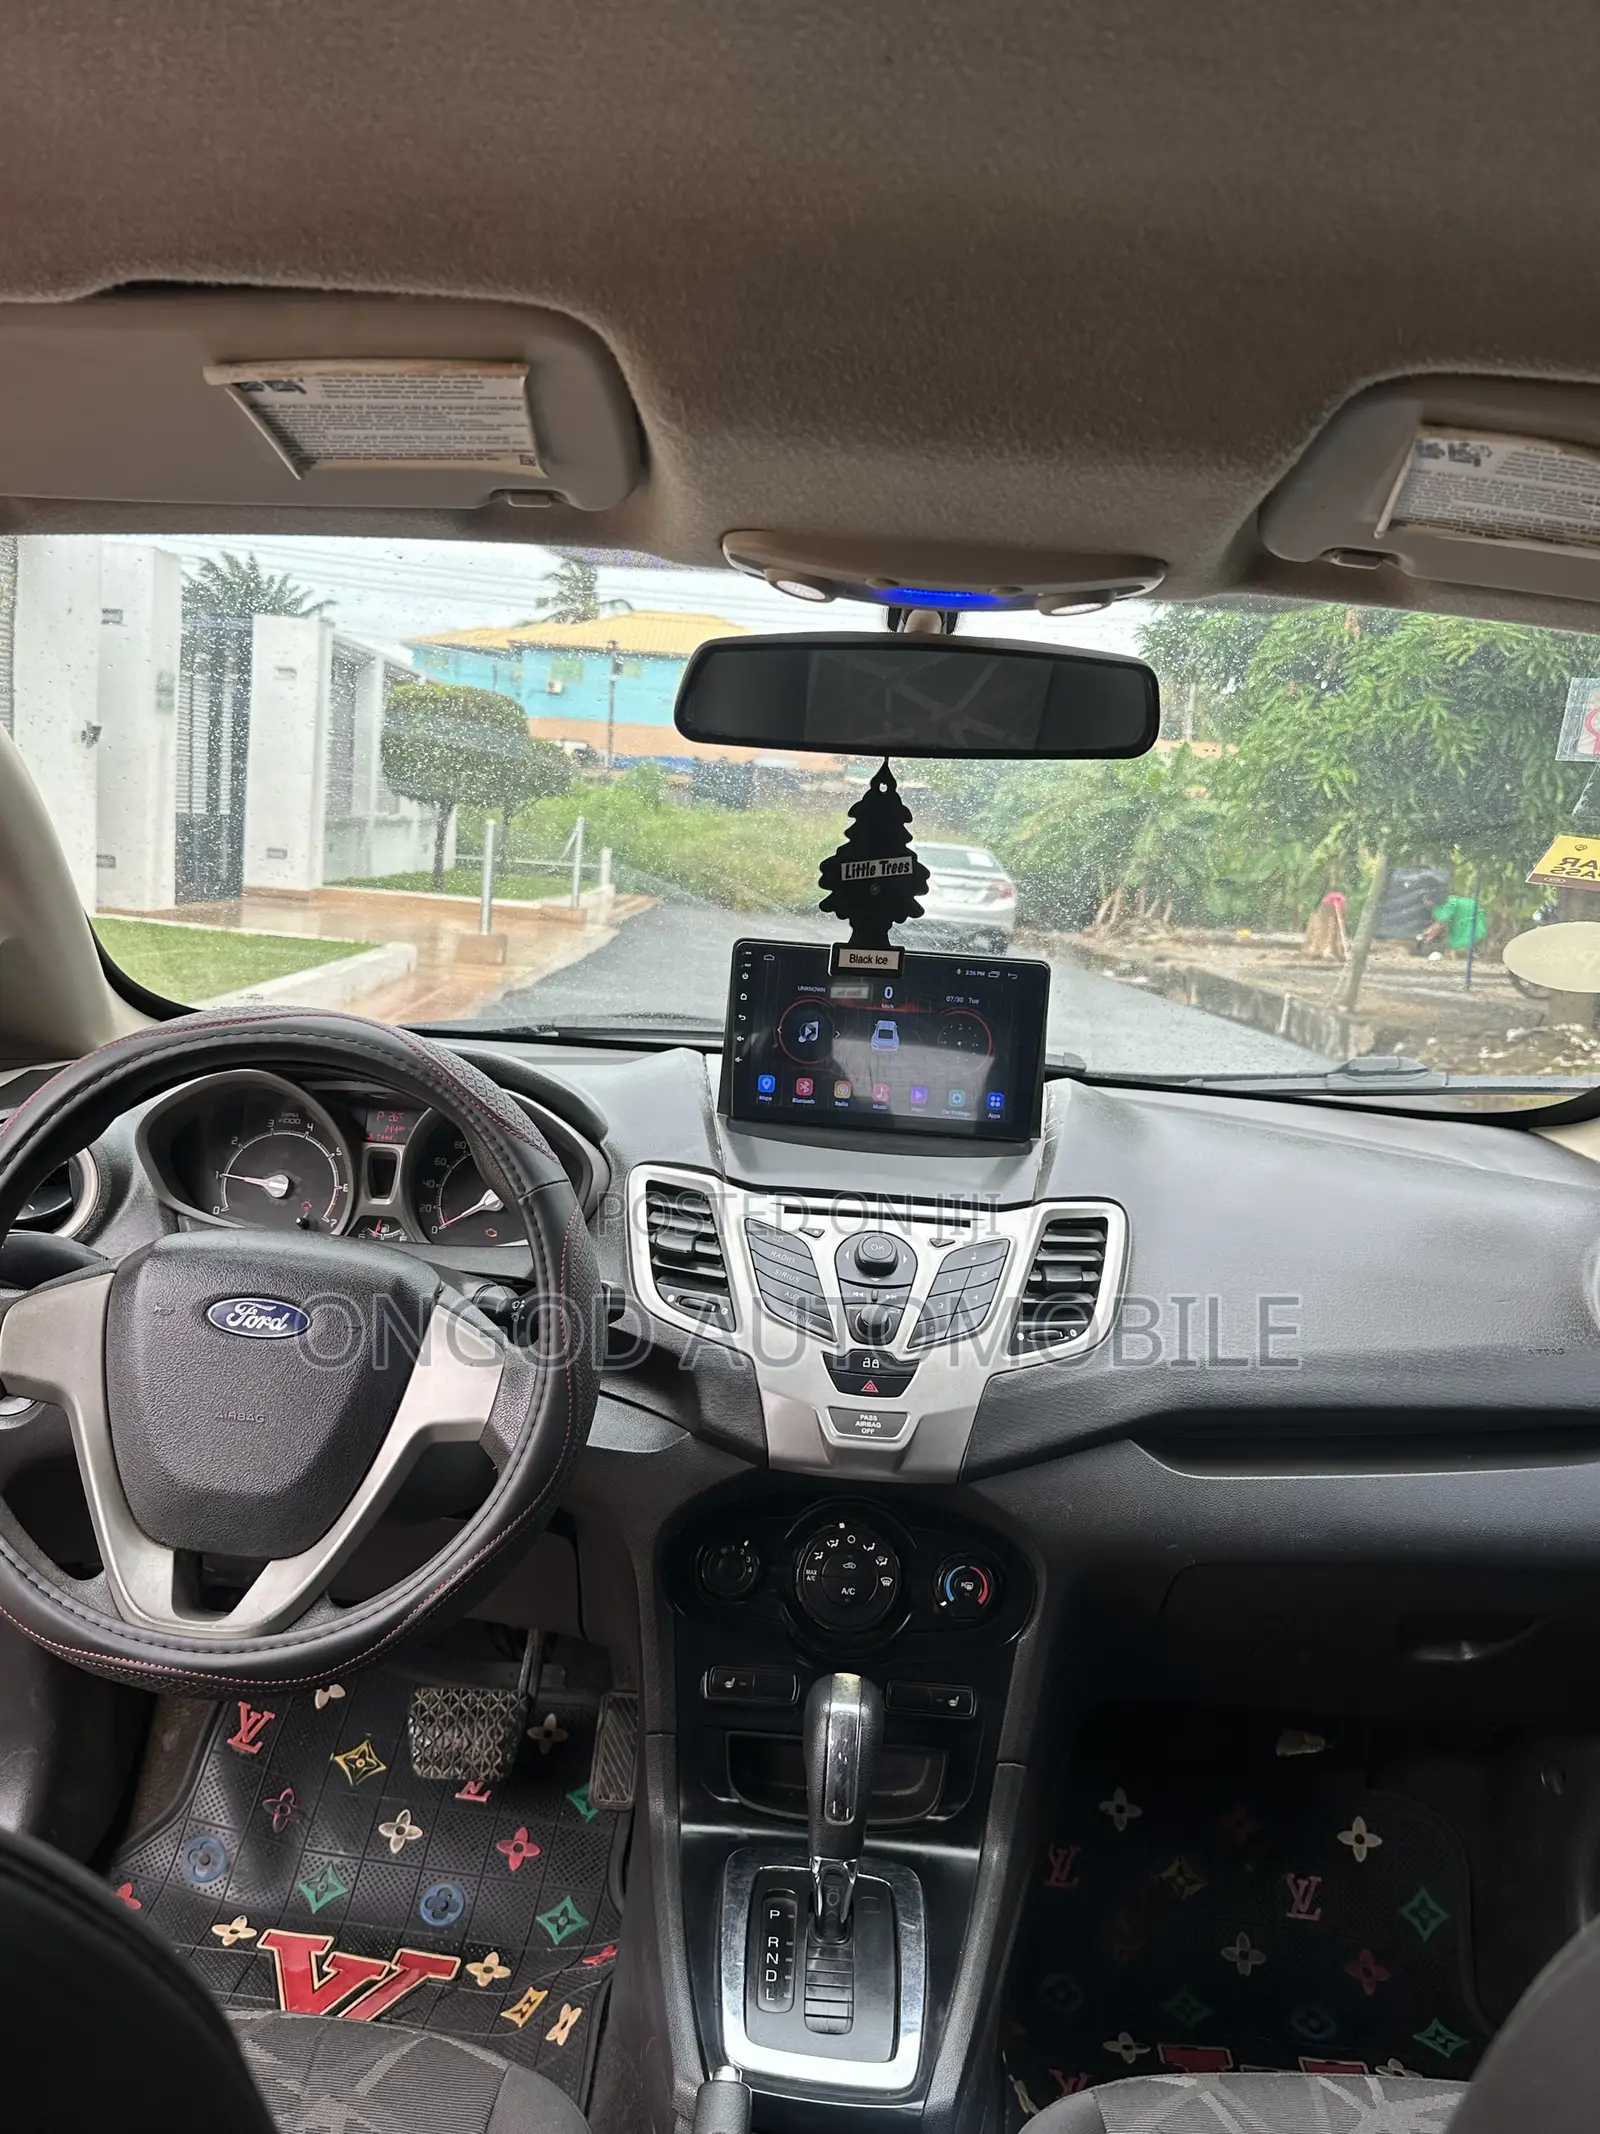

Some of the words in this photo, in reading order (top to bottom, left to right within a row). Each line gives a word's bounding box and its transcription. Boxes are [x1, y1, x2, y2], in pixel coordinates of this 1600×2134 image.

[845, 861, 876, 879] Little
[879, 859, 910, 876] Trees
[849, 953, 873, 964] Black
[875, 956, 888, 965] Ice
[884, 986, 893, 999] 0
[946, 995, 964, 1003] 07/30
[968, 997, 980, 1005] Tue
[268, 1120, 274, 1128] 3
[307, 1123, 313, 1131] 4
[231, 1137, 238, 1145] 2
[336, 1147, 342, 1156] 5
[434, 1158, 447, 1166] 60
[423, 1180, 435, 1188] 40
[213, 1206, 220, 1214] 0
[419, 1204, 432, 1212] 20
[330, 1219, 337, 1227] 7
[431, 1226, 438, 1234] 0
[870, 1243, 885, 1251] OK
[770, 1251, 795, 1264] RADIO
[773, 1269, 800, 1283] SIRIUS
[226, 1302, 291, 1331] Ford
[789, 1310, 813, 1324] MENU
[215, 1411, 265, 1423] AIRBAG
[841, 1587, 856, 1596] A/C
[769, 1909, 781, 1919] P
[767, 1936, 779, 1948] R
[766, 1952, 779, 1965] N
[765, 1969, 777, 1982] D
[765, 1987, 775, 2001] L
